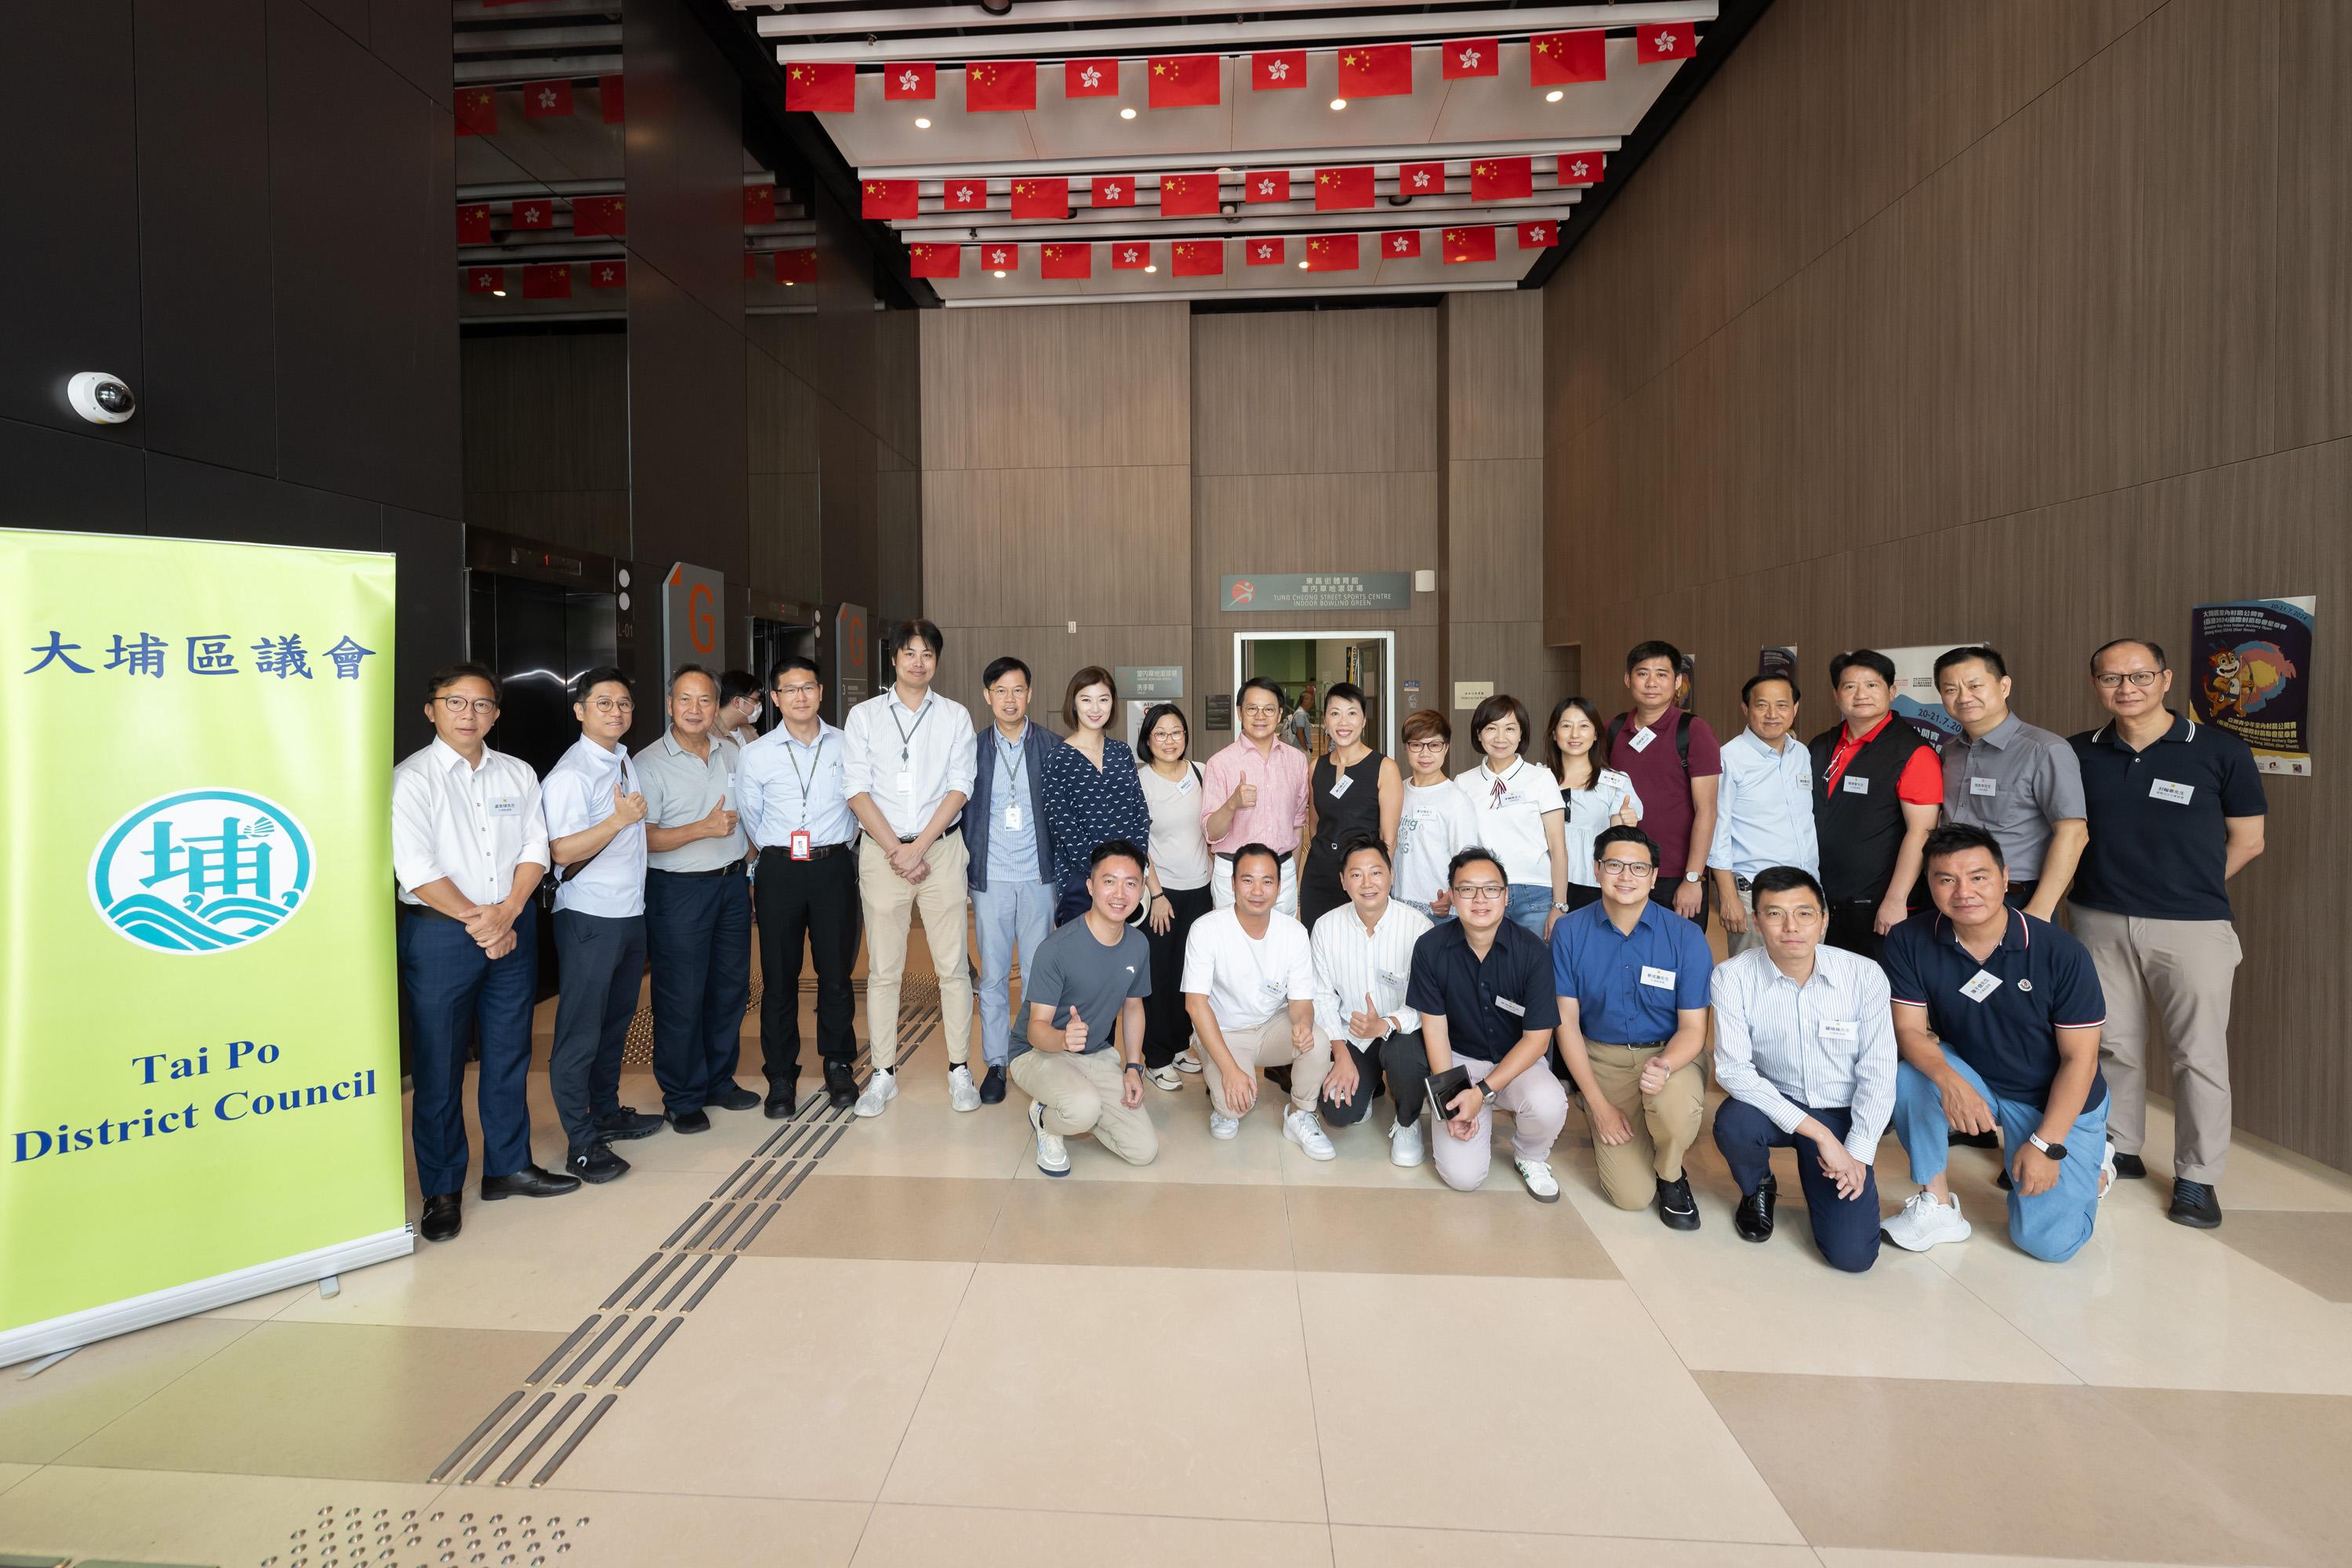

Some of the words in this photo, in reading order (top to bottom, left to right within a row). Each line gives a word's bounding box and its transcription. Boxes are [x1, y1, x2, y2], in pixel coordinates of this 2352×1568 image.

[689, 583, 715, 654] G
[850, 615, 864, 666] G
[23, 630, 376, 680] 大埔區議會
[842, 684, 846, 696] 3
[140, 816, 276, 901] 埔
[132, 1046, 212, 1086] Tai
[226, 1040, 281, 1070] Po
[11, 1102, 200, 1165] District
[214, 1069, 377, 1122] Council
